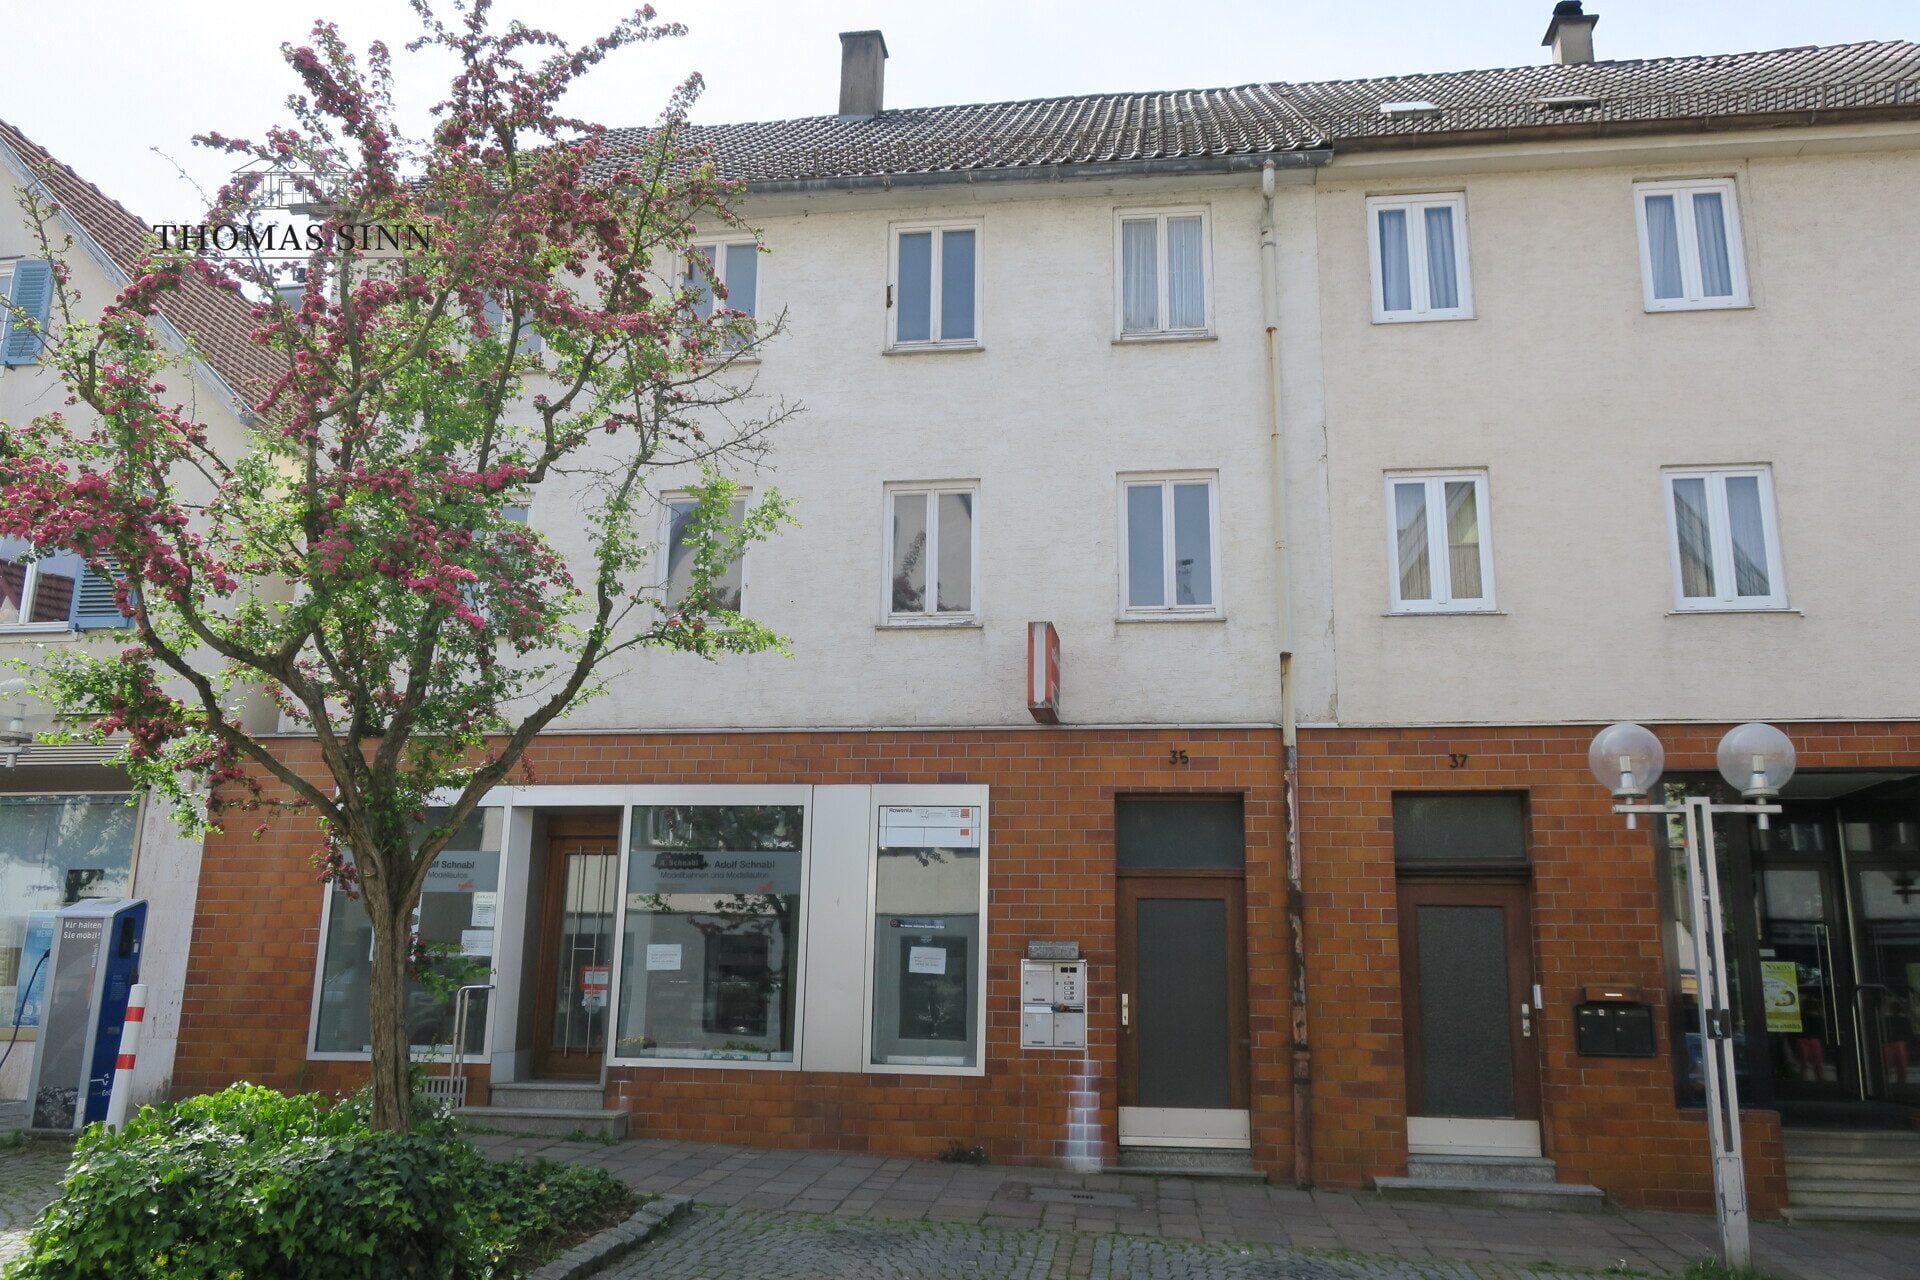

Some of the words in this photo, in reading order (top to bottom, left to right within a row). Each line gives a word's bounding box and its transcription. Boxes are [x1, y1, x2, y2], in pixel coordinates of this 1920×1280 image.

[1169, 750, 1189, 765] 35
[1449, 753, 1468, 768] 37
[441, 860, 475, 869] Schnabl
[714, 860, 737, 869] Adolf
[739, 860, 775, 869] Schnabl
[660, 871, 709, 879] Modellbahnen
[65, 921, 78, 929] Wir
[78, 921, 102, 929] halten
[63, 931, 76, 939] Sie
[76, 931, 101, 939] mobil!
